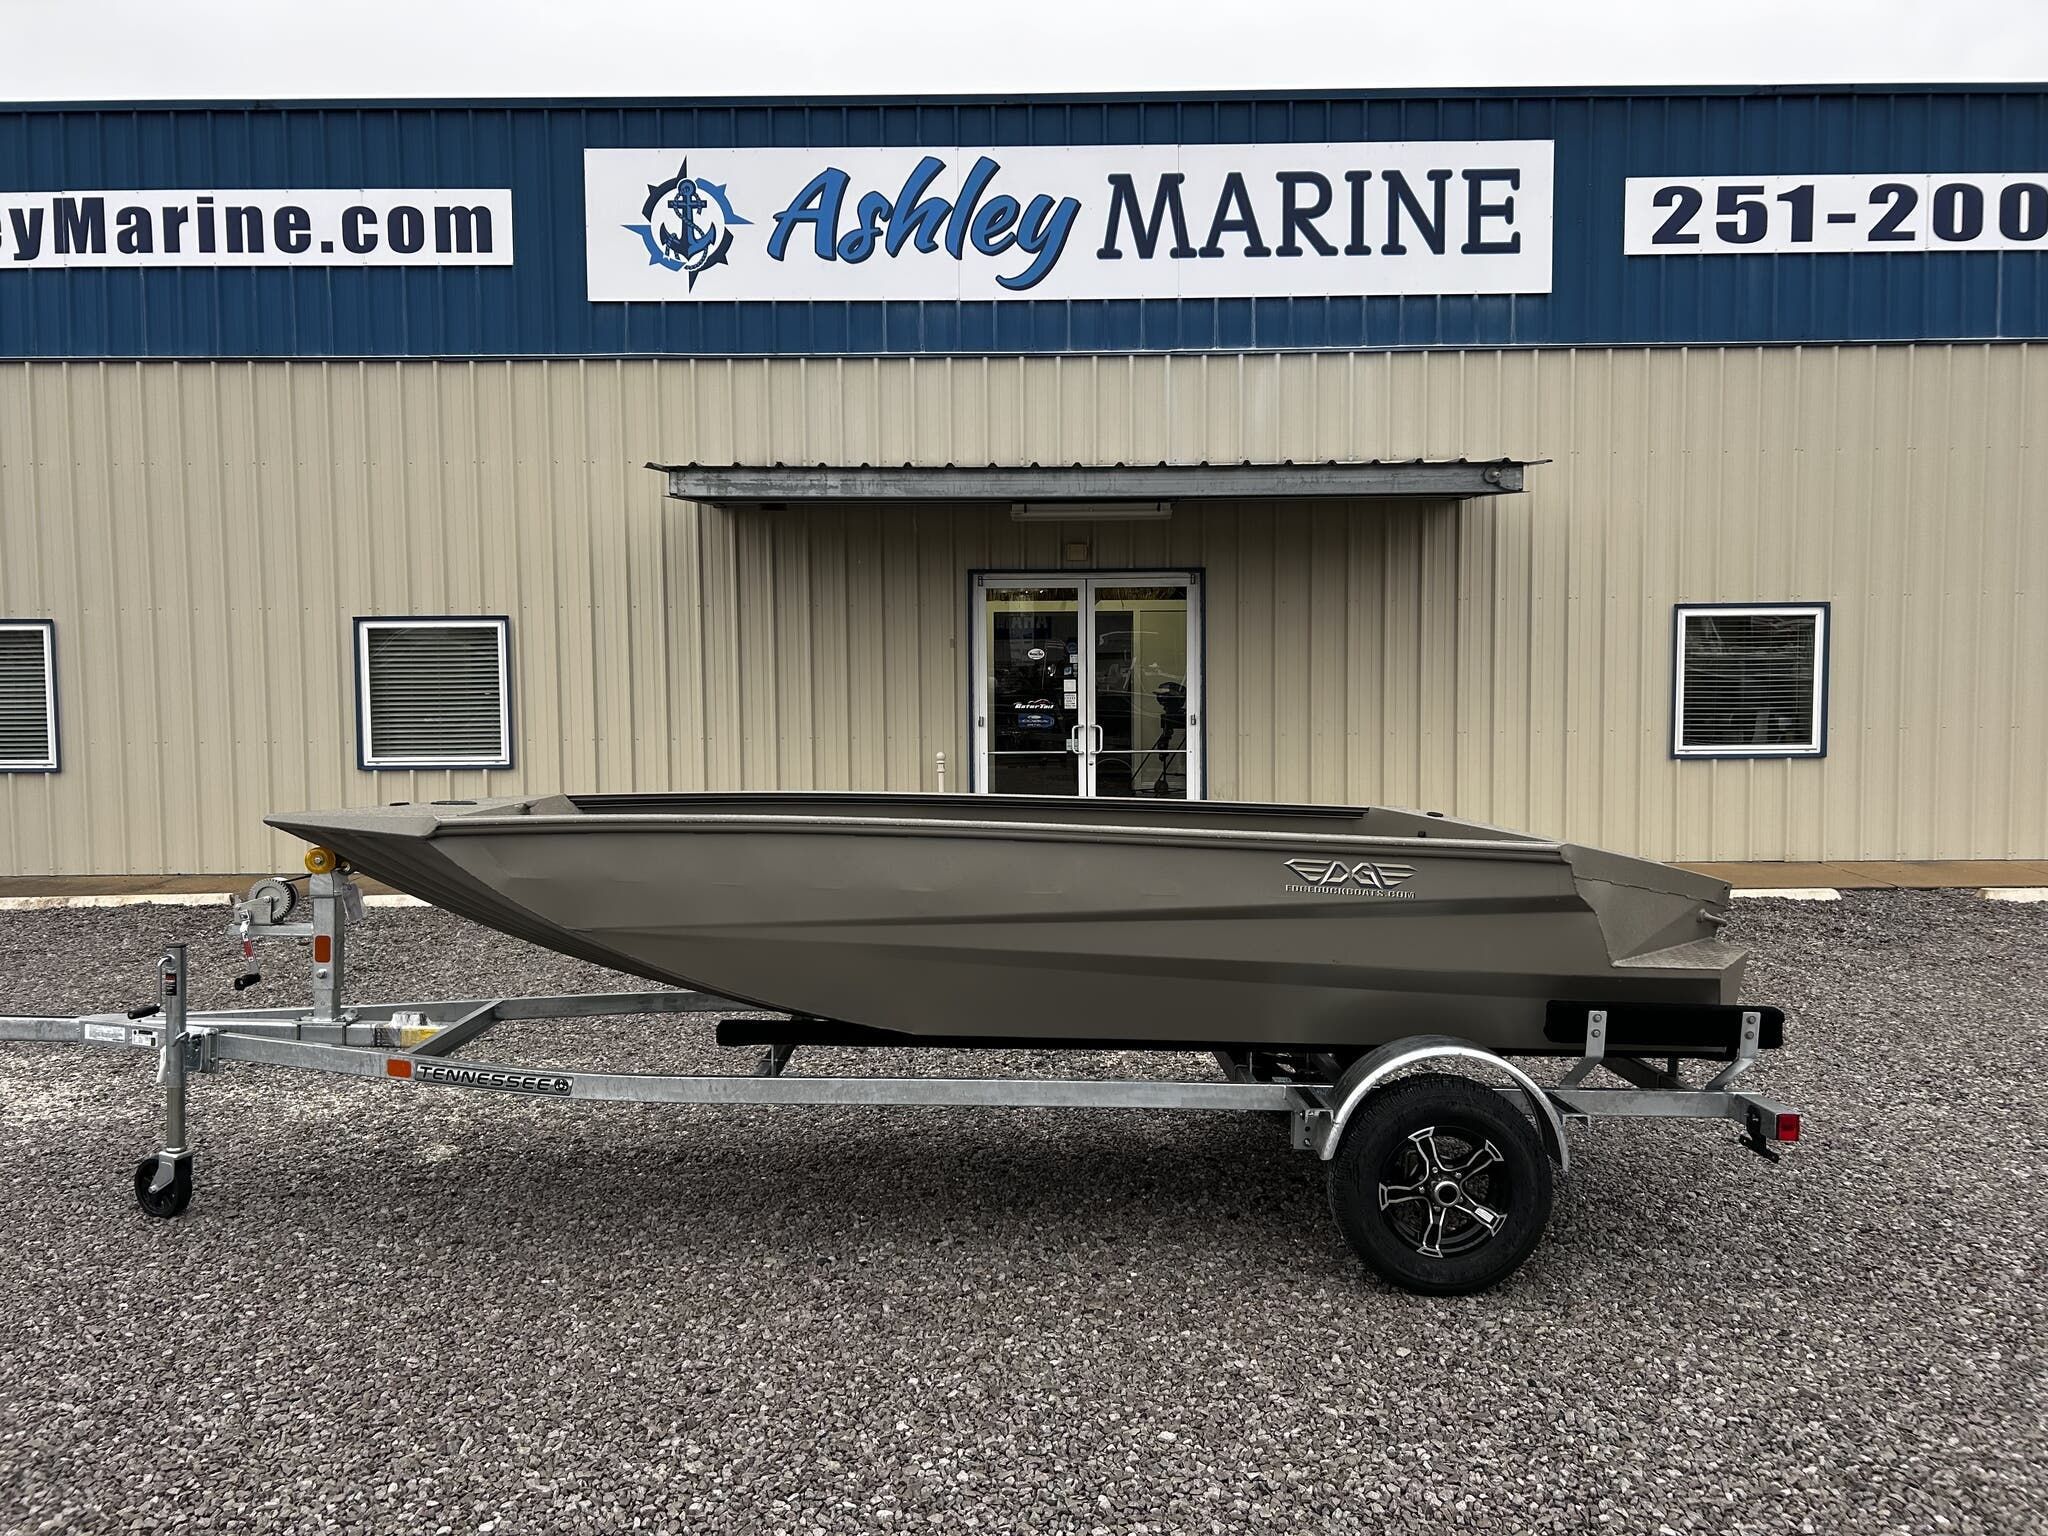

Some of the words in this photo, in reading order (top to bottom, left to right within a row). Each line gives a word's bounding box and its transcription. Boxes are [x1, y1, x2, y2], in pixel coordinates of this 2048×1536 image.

[0, 196, 493, 261] yMarine.com
[766, 155, 1082, 291] Ashley
[1096, 168, 1521, 259] MARINE
[1651, 182, 2048, 245] 251-200
[419, 1065, 552, 1091] TENNESSEE
